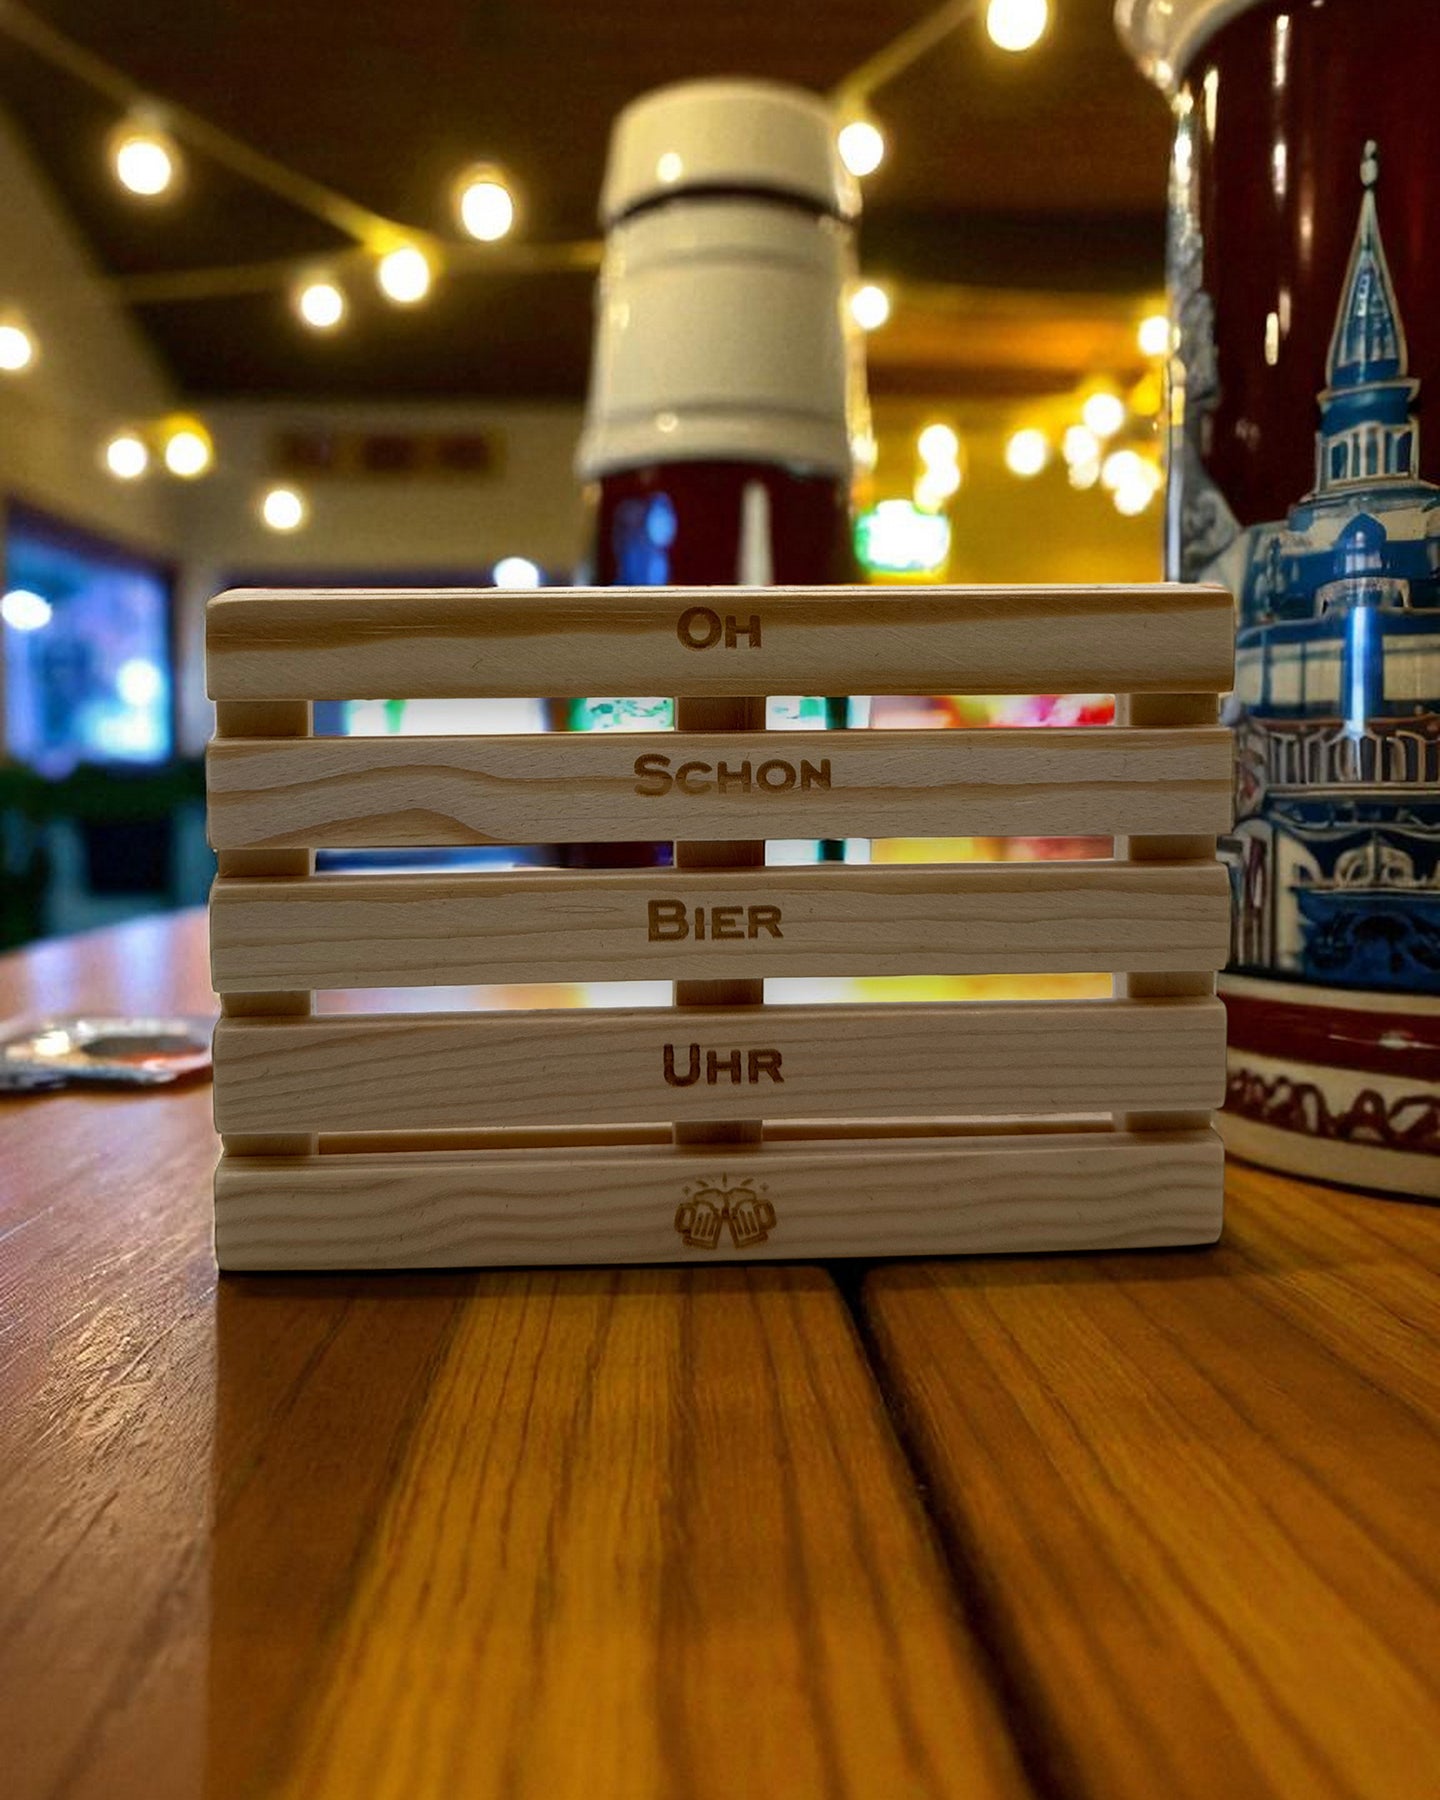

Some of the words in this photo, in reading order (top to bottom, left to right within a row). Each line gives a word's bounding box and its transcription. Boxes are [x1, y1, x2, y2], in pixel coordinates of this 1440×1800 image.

[677, 606, 762, 650] OH
[633, 753, 832, 797] SCHON
[647, 899, 784, 942] BIER
[663, 1042, 785, 1087] UHR
